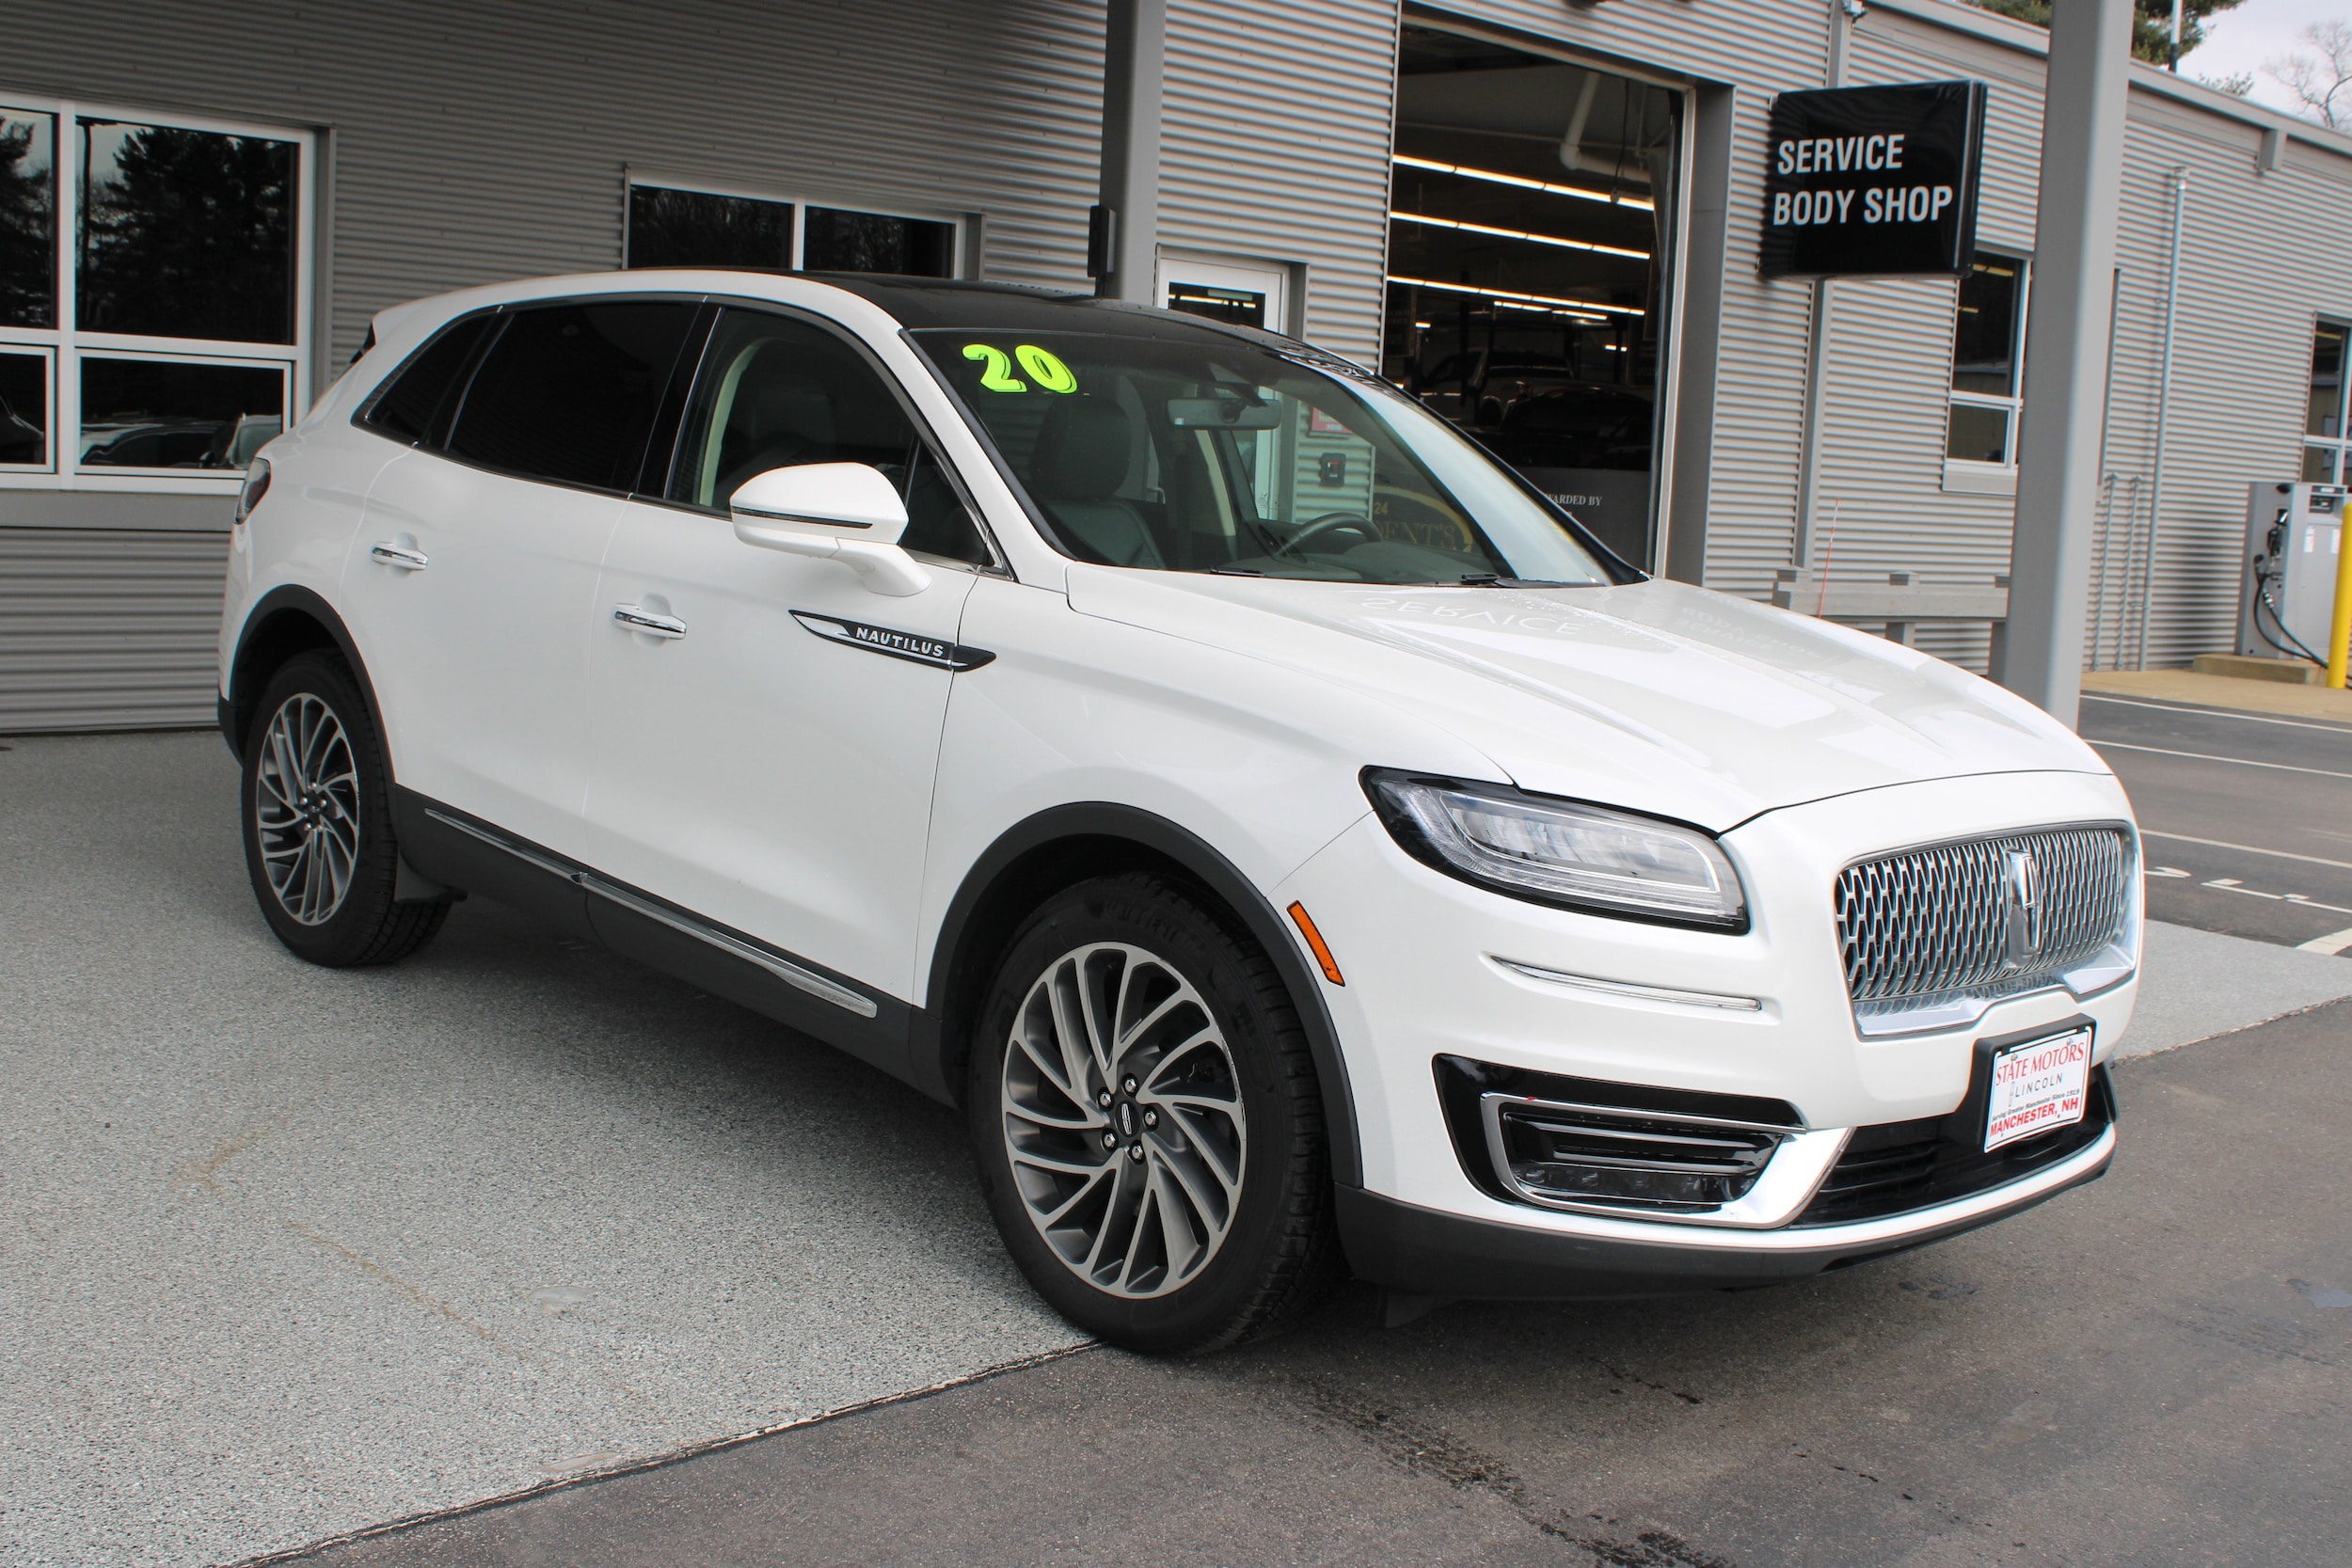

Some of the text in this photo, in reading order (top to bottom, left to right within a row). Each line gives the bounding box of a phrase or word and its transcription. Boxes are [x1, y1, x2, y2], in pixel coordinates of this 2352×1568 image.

[1777, 134, 1905, 175] SERVICE
[1772, 185, 1953, 226] BODY SHOP
[961, 343, 1078, 394] 20
[1546, 493, 1603, 507] WARDED BY
[855, 626, 944, 657] NAUTILUS
[1995, 1041, 2085, 1086] STATE MOTORS
[2014, 1072, 2063, 1098] LINCOLN
[1989, 1097, 2079, 1137] MANCHESTER, NH
